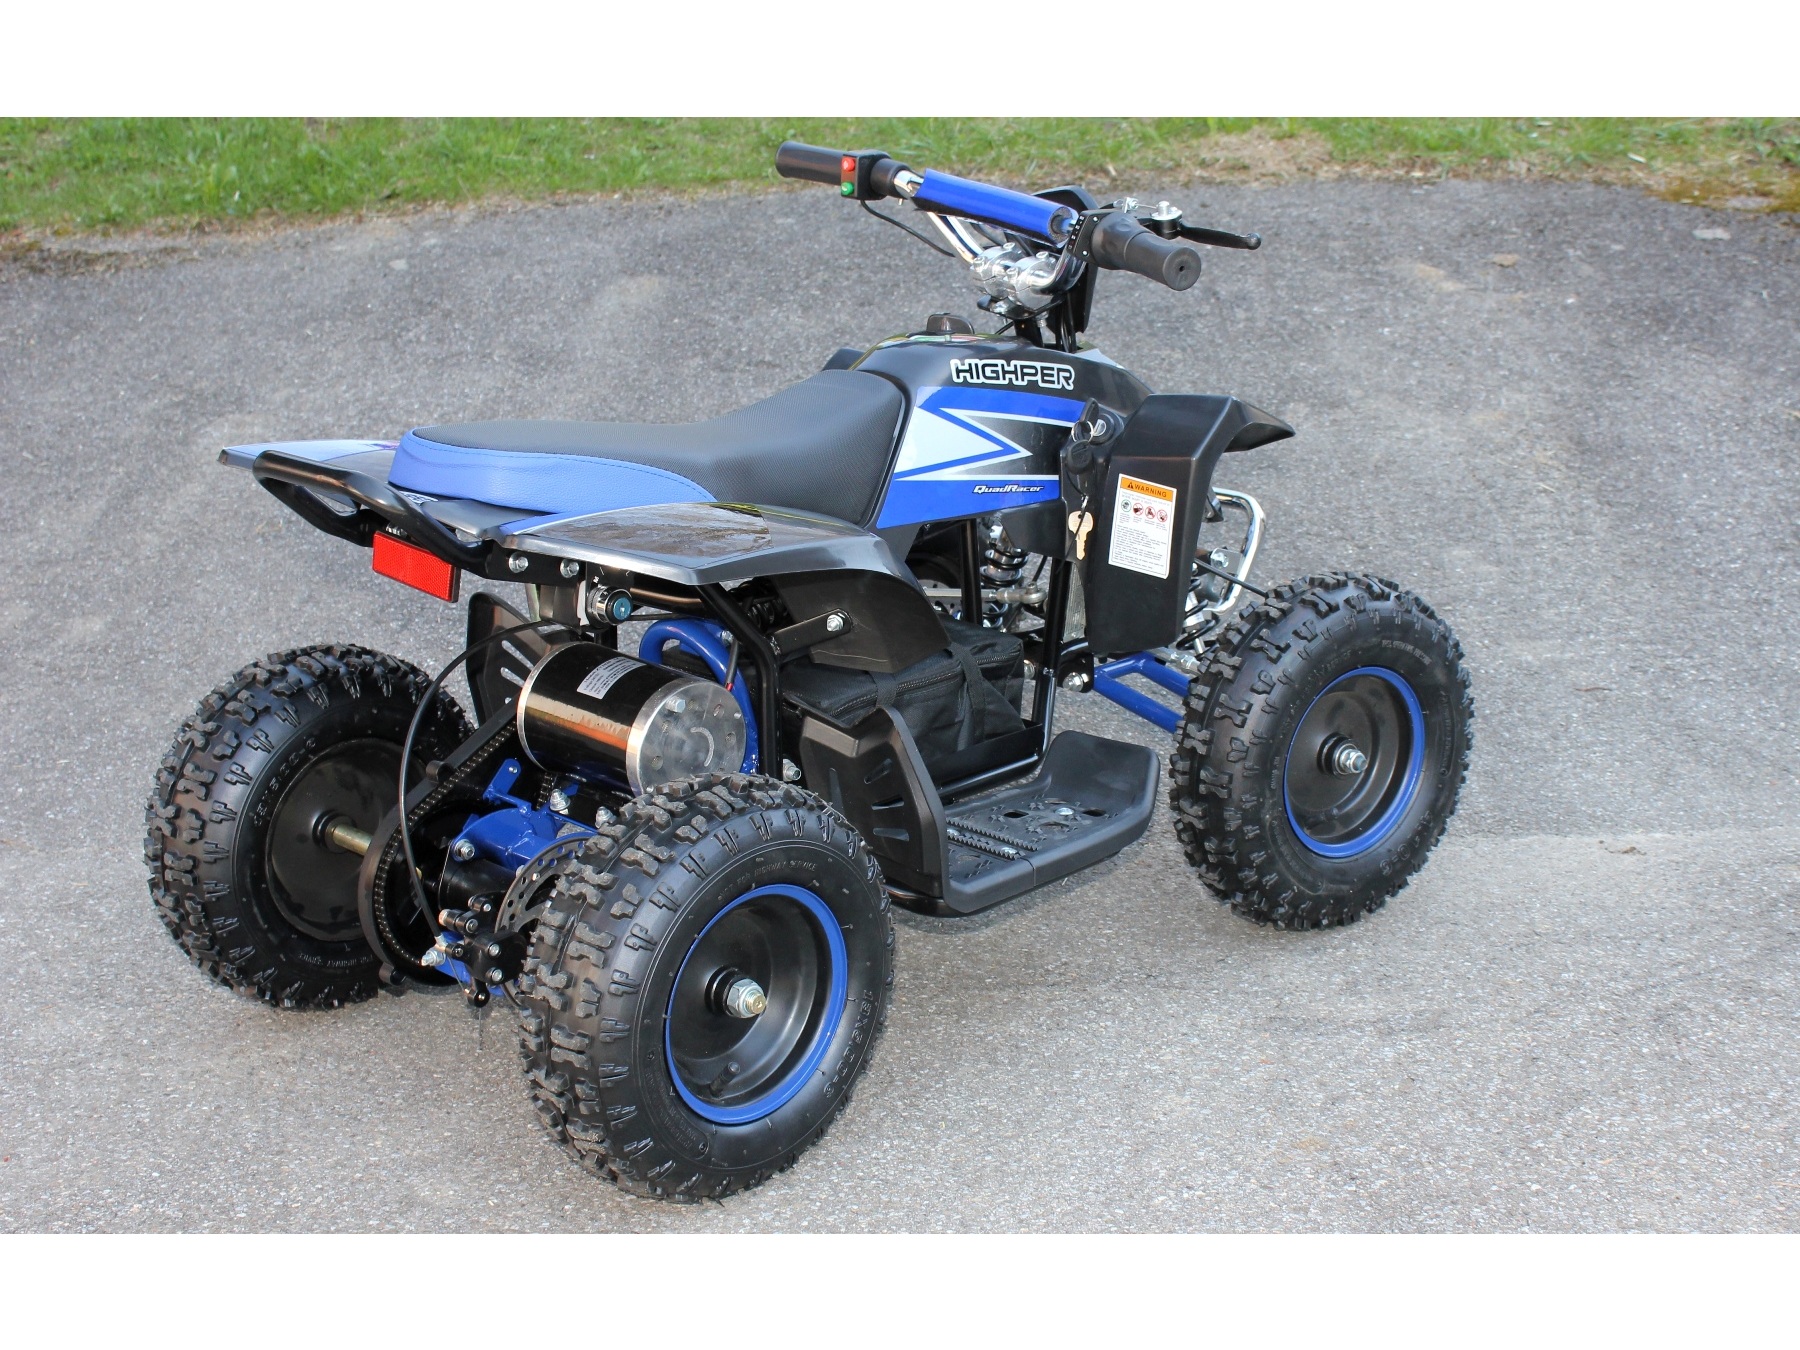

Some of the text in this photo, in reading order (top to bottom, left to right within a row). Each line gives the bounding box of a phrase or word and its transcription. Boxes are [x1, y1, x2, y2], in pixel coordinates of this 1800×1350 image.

[950, 359, 1075, 390] HIGHPER
[973, 484, 1043, 494] QuadRacer
[1134, 484, 1167, 498] WARNING
[754, 860, 787, 877] HIGHWAY
